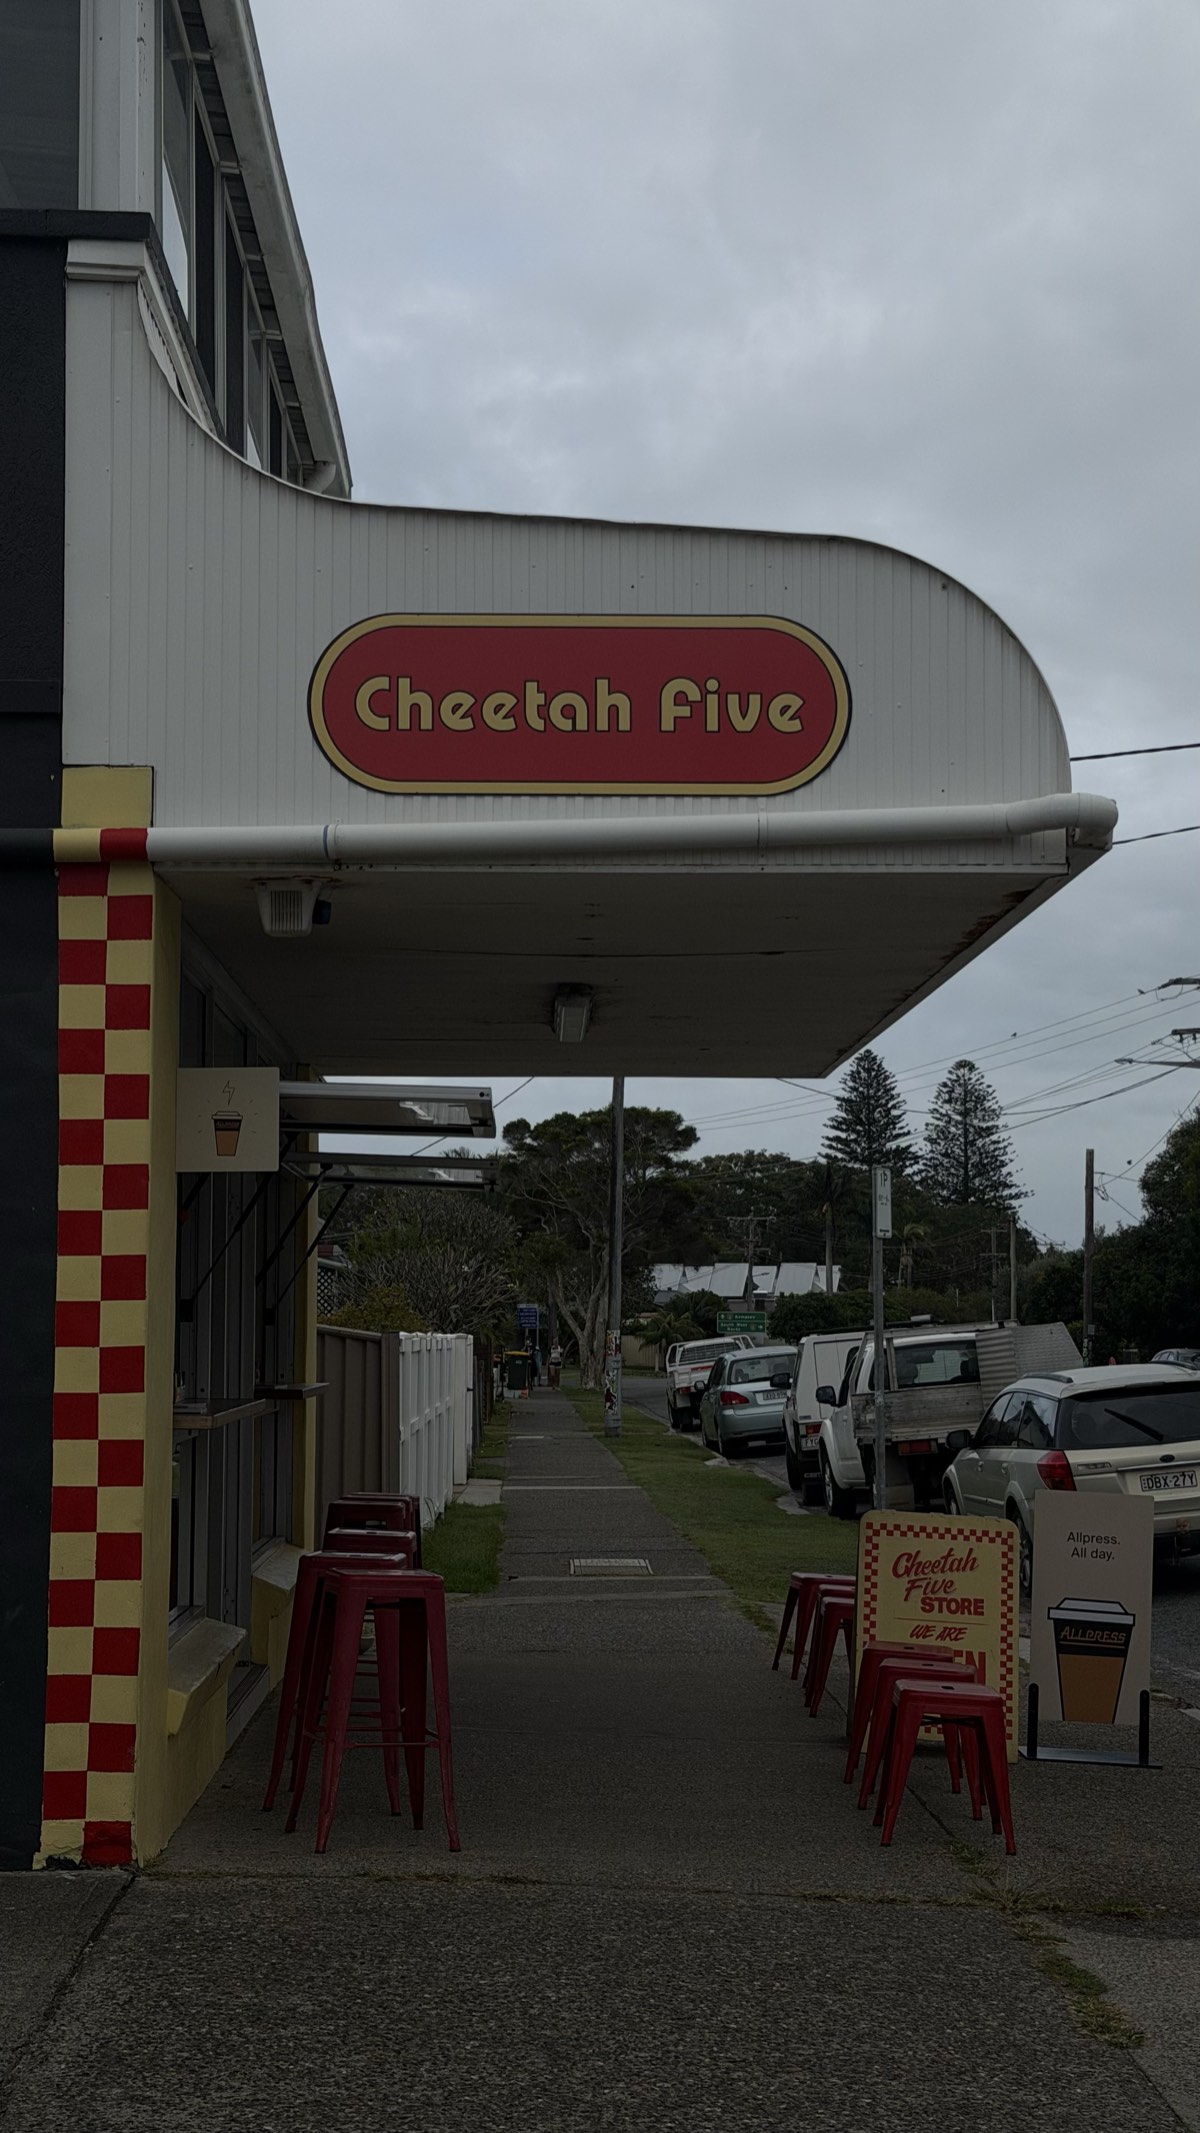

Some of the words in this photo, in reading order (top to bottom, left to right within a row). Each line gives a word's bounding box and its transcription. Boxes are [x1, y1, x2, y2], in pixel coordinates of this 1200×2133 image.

[354, 675, 632, 732] Cheetah
[659, 677, 805, 733] Five
[1067, 1531, 1121, 1545] Allpress.
[892, 1548, 979, 1578] Cheetah
[1071, 1547, 1087, 1558] All
[1090, 1548, 1115, 1562] day.
[903, 1577, 957, 1601] Five
[920, 1596, 985, 1616] STORE
[909, 1624, 936, 1640] WE
[935, 1626, 968, 1642] ARE
[1059, 1625, 1127, 1643] ALLPRESS
